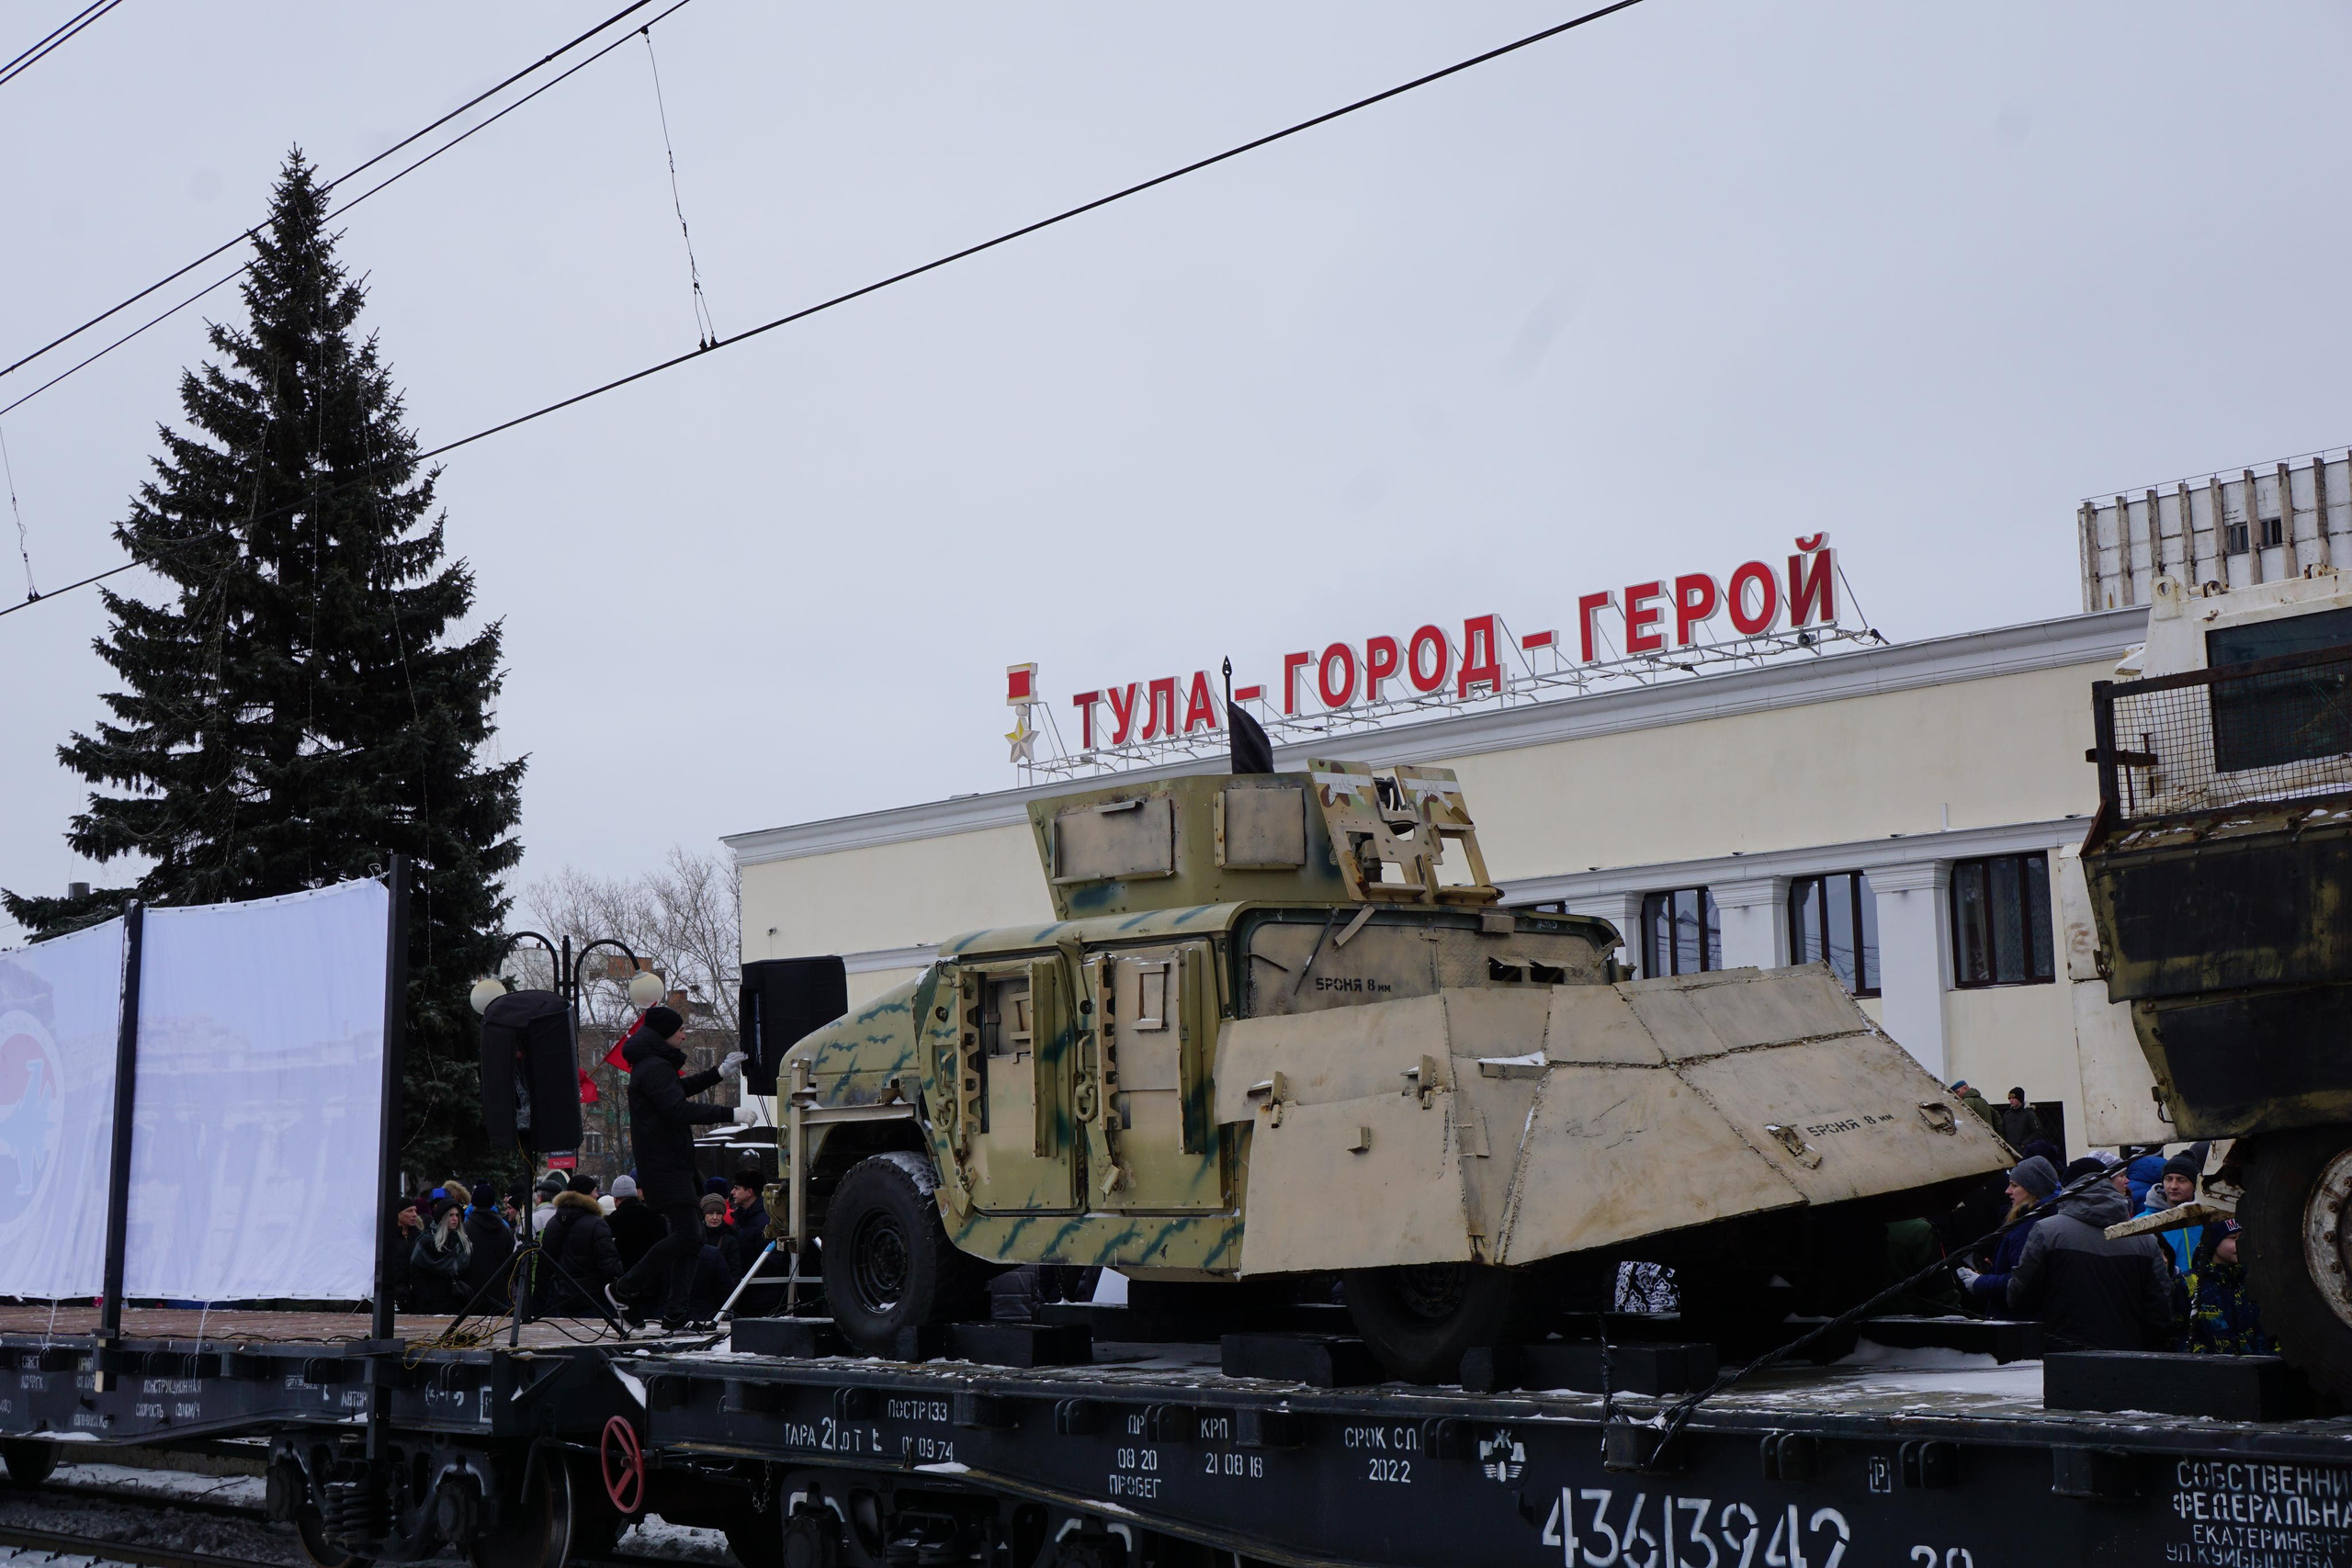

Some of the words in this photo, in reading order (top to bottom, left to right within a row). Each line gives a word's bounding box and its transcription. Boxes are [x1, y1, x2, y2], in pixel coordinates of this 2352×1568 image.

[1577, 531, 1838, 664] ГЕРОЙ
[1316, 977, 1363, 993] БРОНЯ
[1367, 978, 1375, 991] 8
[1806, 1119, 1860, 1137] БРОНЯ
[1863, 1115, 1877, 1125] 8
[785, 1423, 817, 1447] ТАРА
[1201, 1417, 1228, 1439] КРП
[1344, 1427, 1387, 1450] СРОК
[937, 1440, 954, 1461] 74
[1117, 1448, 1136, 1469] 08
[1140, 1450, 1158, 1471] 20
[1204, 1452, 1218, 1474] 21
[1224, 1453, 1243, 1476] 08
[1250, 1456, 1263, 1478] 18
[1368, 1458, 1411, 1483] 2022
[1109, 1474, 1162, 1499] ПРОБЕГ
[2177, 1461, 2352, 1497] СОБСТВЕННИ
[1542, 1486, 1850, 1568] 43613942
[2192, 1525, 2351, 1555] ЕКАТЕРИНБУРГ
